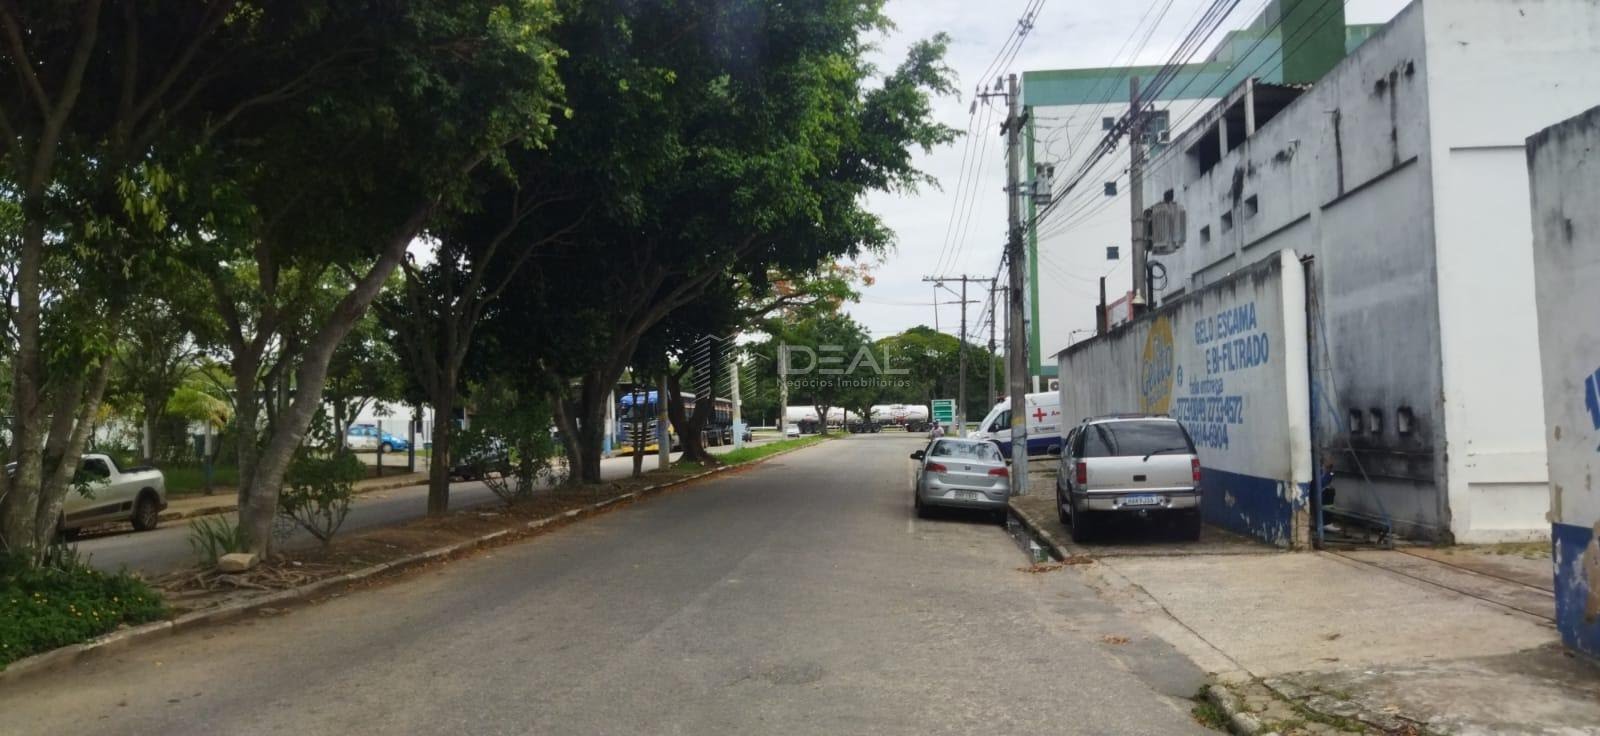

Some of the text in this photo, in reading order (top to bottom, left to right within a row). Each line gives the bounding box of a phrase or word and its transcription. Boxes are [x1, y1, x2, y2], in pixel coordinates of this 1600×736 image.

[1195, 301, 1257, 345] GELO ESCAMA
[1212, 332, 1269, 374] BI-FILTRADO
